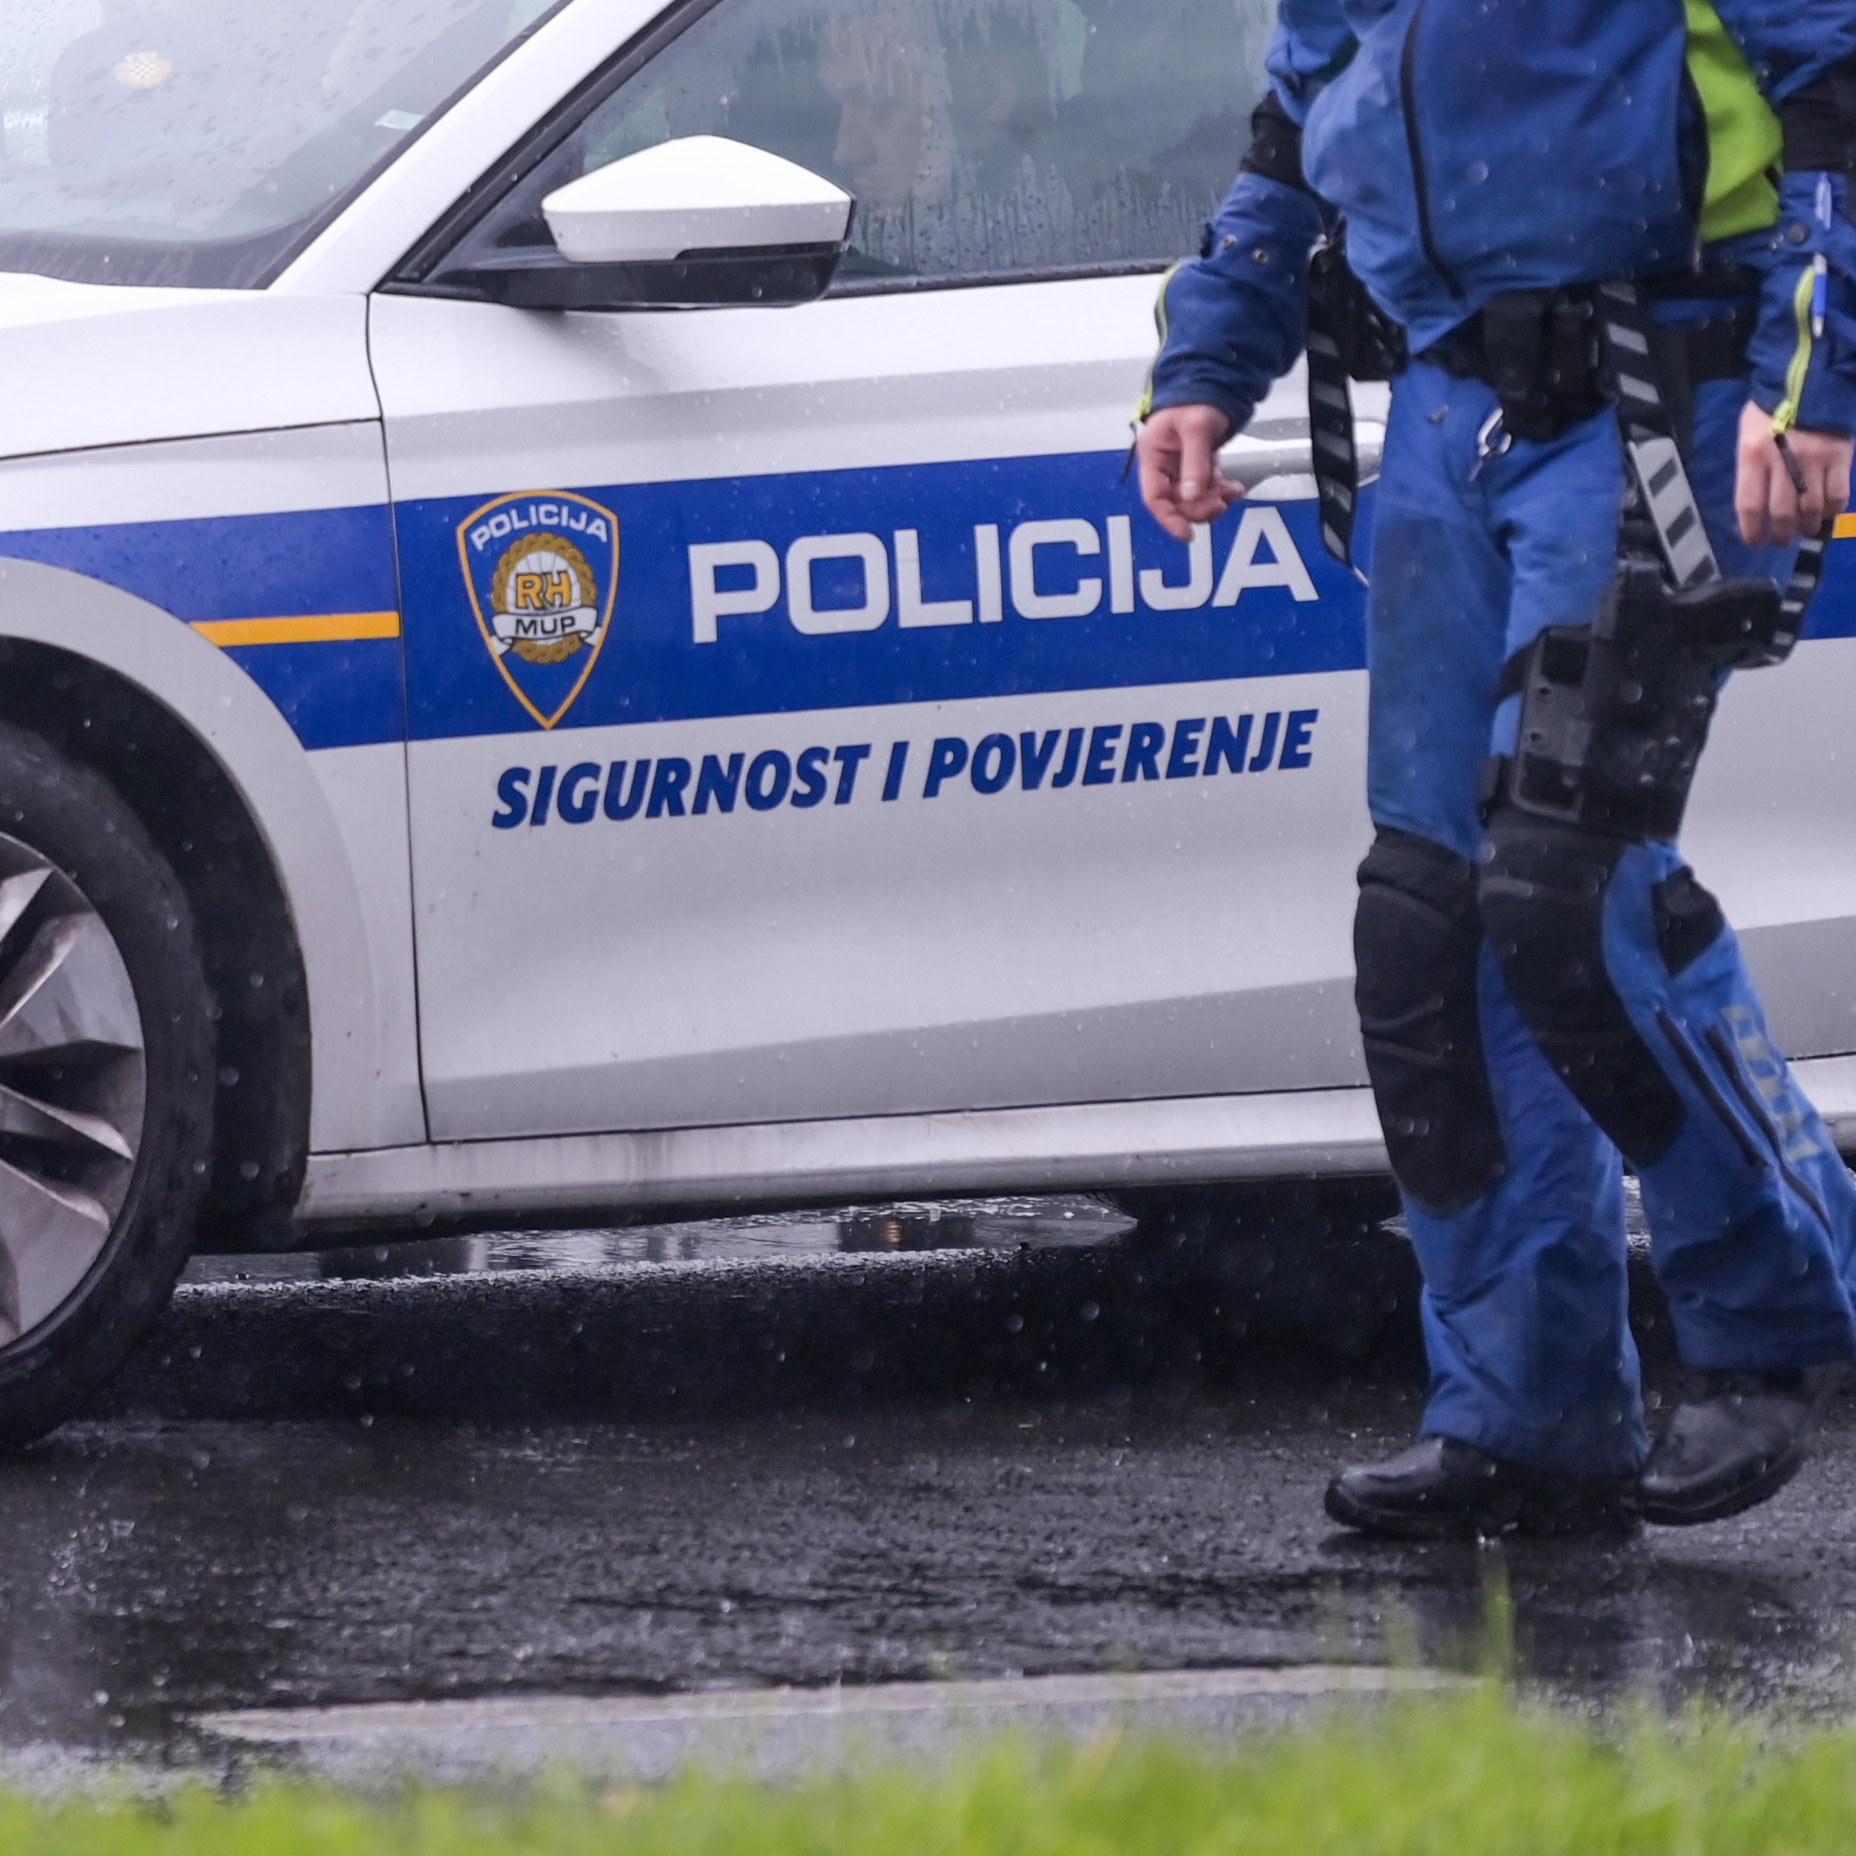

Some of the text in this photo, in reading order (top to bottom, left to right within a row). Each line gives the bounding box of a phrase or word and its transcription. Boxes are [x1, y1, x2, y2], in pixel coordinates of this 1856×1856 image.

[470, 503, 608, 552] POLICIJA
[515, 569, 573, 610] RH
[687, 506, 1320, 644] POLICIJA
[515, 615, 576, 636] MUP
[491, 707, 1321, 830] SIGURNOST I POVJERENJE
